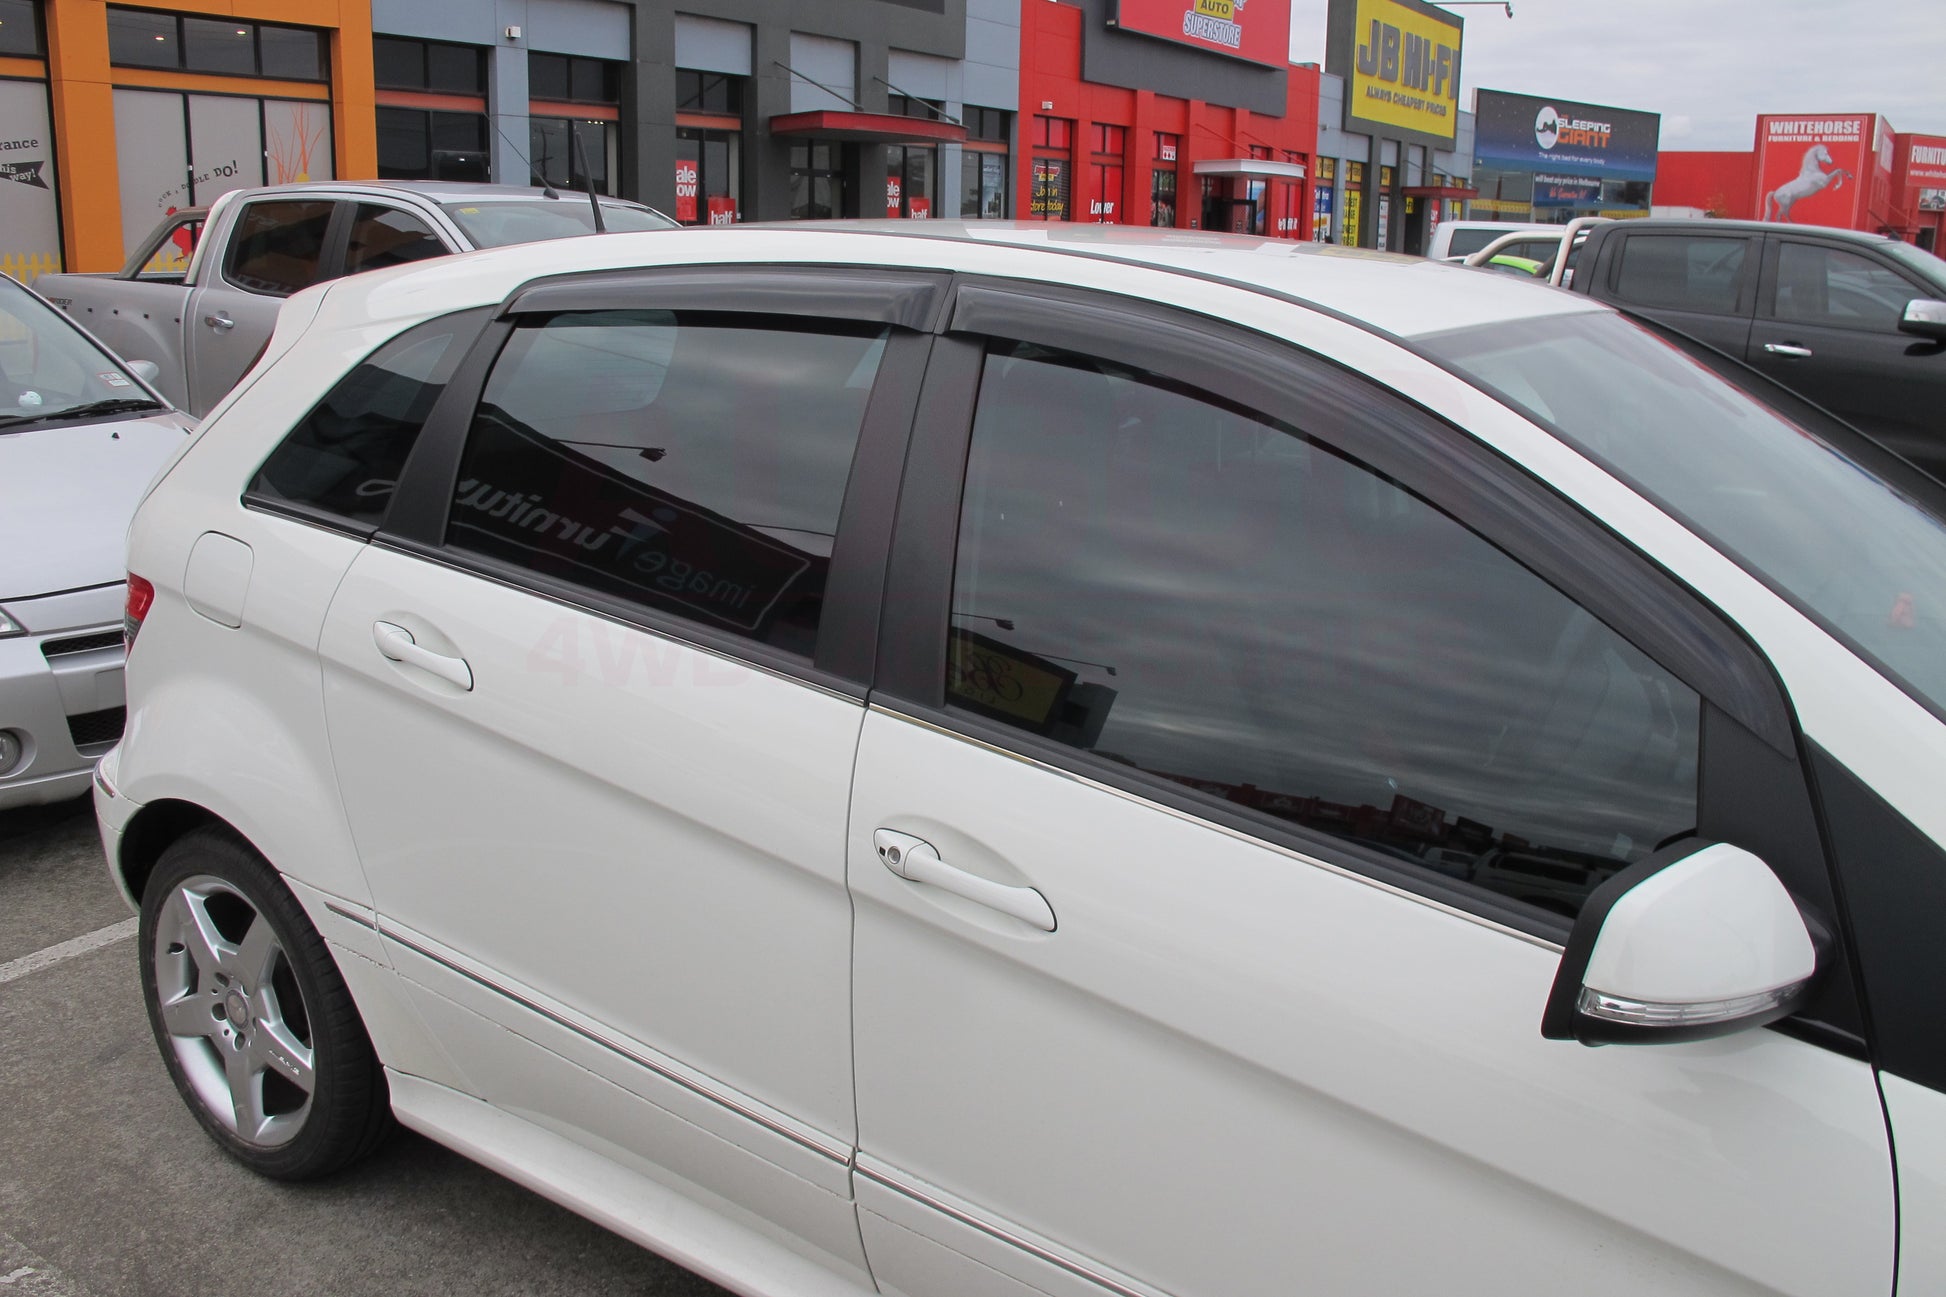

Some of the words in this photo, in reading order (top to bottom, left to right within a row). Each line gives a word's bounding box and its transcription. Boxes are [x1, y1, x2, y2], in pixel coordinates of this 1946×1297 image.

[1200, 0, 1230, 14] AUTO
[1184, 11, 1240, 46] SUPERSTORE
[1357, 18, 1401, 83] JB
[1402, 31, 1459, 100] HI-FI
[1366, 85, 1392, 103] ALWAYS
[1393, 92, 1425, 112] CHEAPEST
[1425, 101, 1447, 117] PRICES
[1558, 118, 1611, 133] SLEEPING
[1769, 121, 1860, 135] WHITEHORSE
[1558, 127, 1612, 148] GIANT
[1767, 134, 1813, 143] FURNITURE
[1814, 134, 1821, 142] &
[1822, 134, 1860, 142] BEDDING
[9, 168, 36, 181] way!
[181, 173, 210, 190] DODLE
[213, 159, 238, 177] DO!
[711, 210, 733, 225] half
